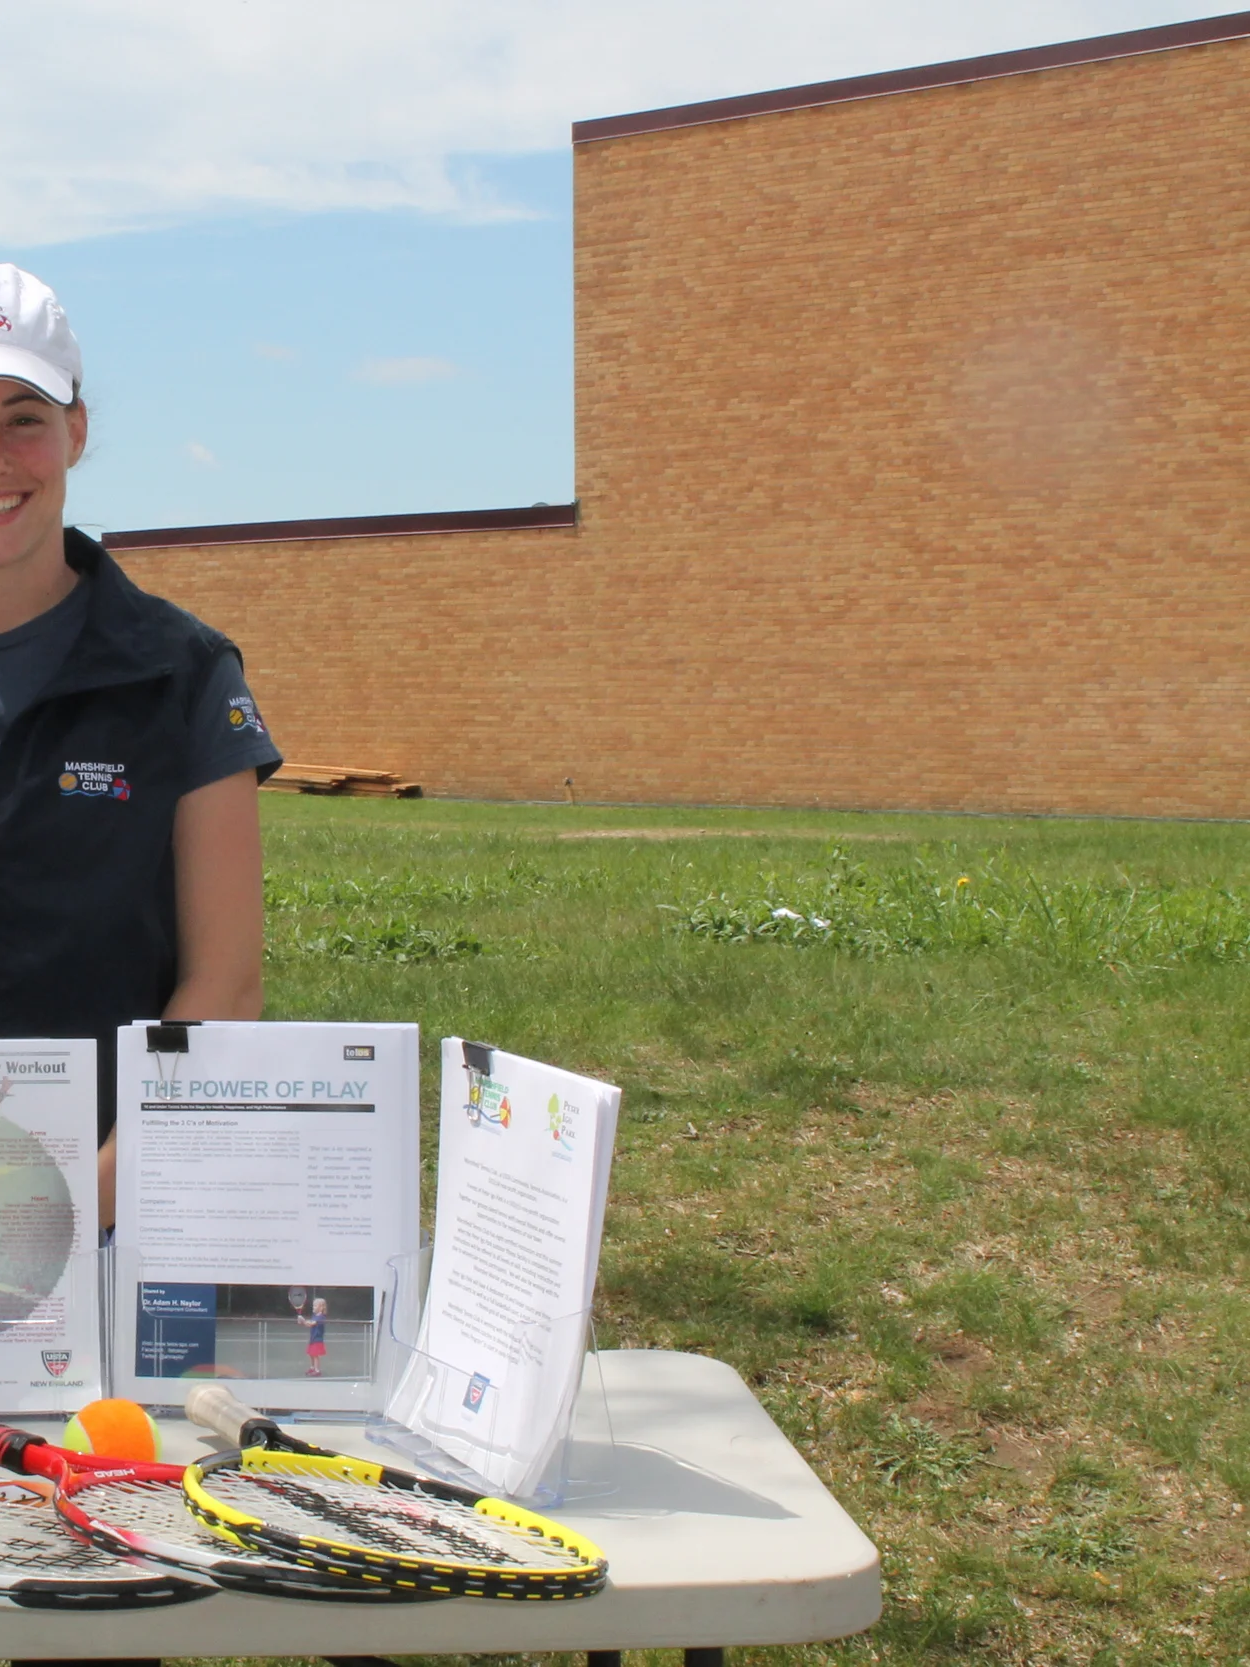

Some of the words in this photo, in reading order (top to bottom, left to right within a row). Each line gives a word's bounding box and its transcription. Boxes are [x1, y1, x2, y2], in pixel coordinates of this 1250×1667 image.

[65, 762, 125, 773] MARSHFIELD
[78, 772, 113, 782] TENNIS
[82, 782, 108, 791] CLUB
[6, 1061, 66, 1075] Workout
[141, 1080, 182, 1098] THE
[189, 1080, 269, 1099] POWER
[275, 1080, 304, 1099] OF
[311, 1081, 368, 1099] PLAY
[93, 1469, 135, 1478] HEAD
